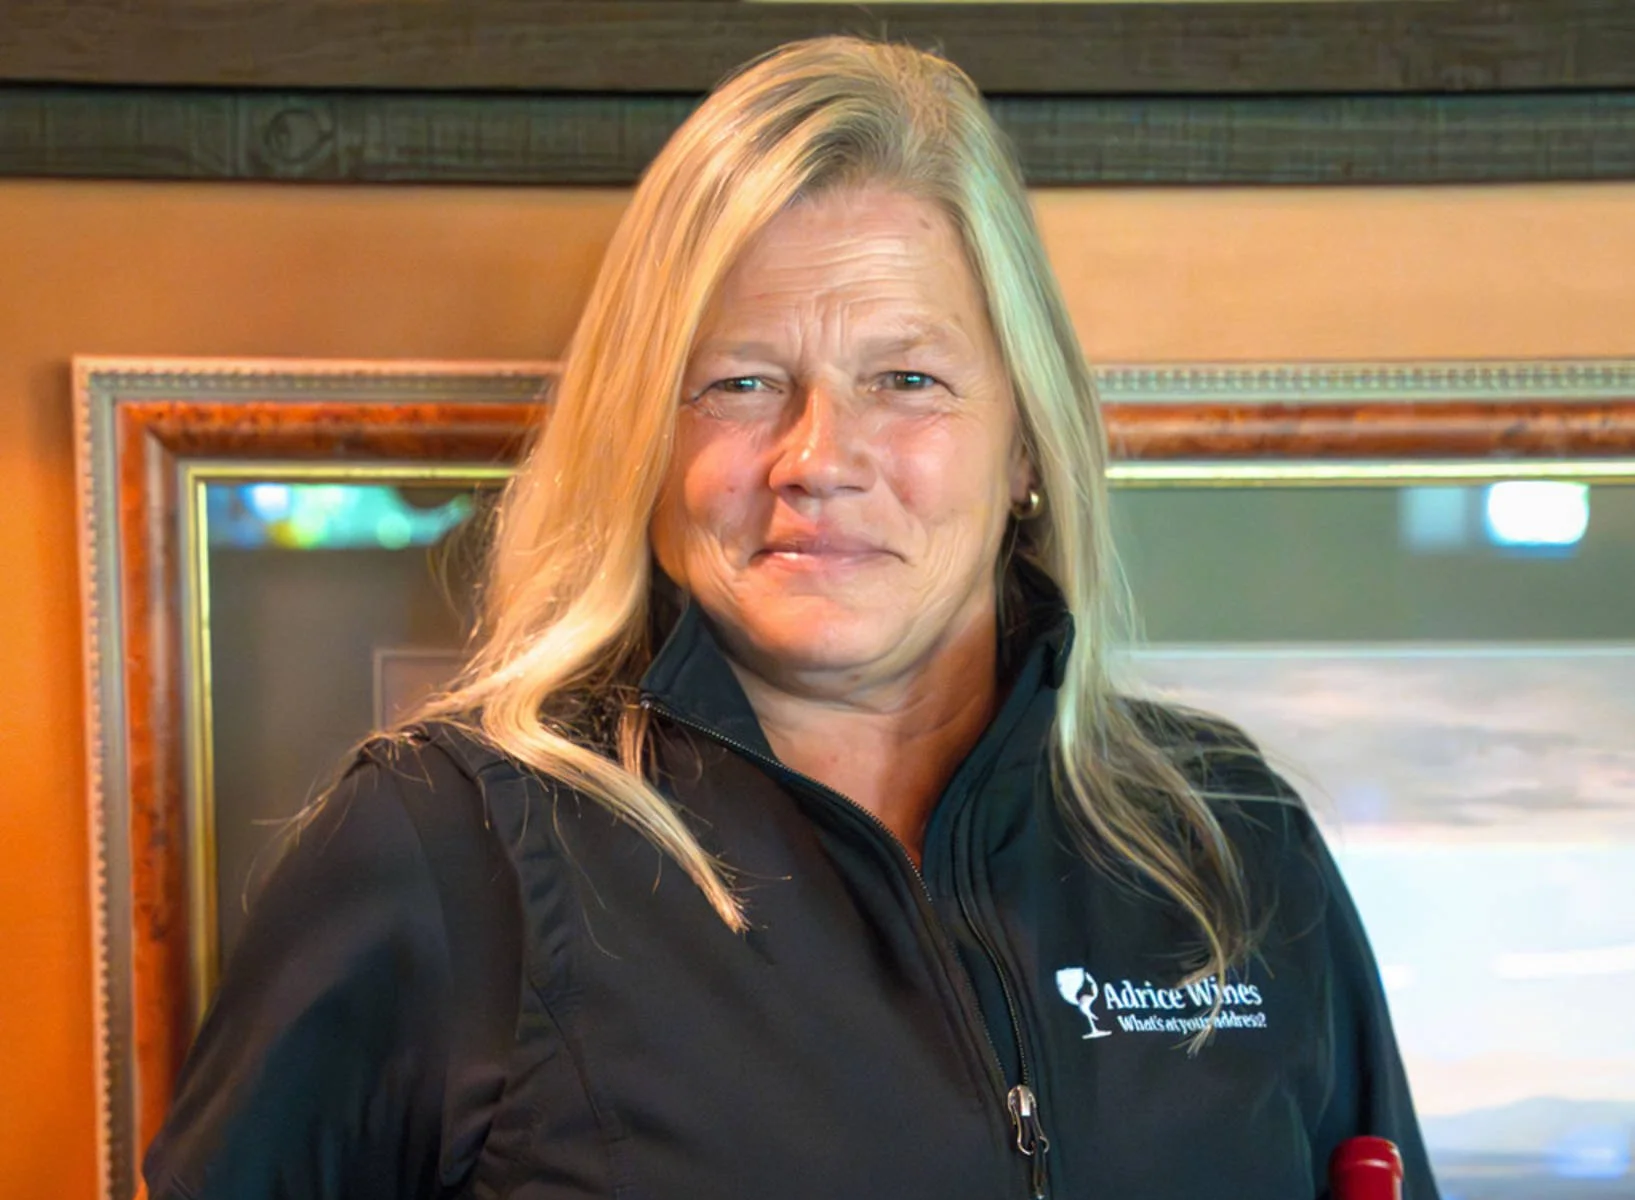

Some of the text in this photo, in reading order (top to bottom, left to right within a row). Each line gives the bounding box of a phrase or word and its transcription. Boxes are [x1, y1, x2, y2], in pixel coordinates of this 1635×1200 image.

[1103, 976, 1263, 1010] Adrice Wines
[1117, 1014, 1165, 1032] What's
